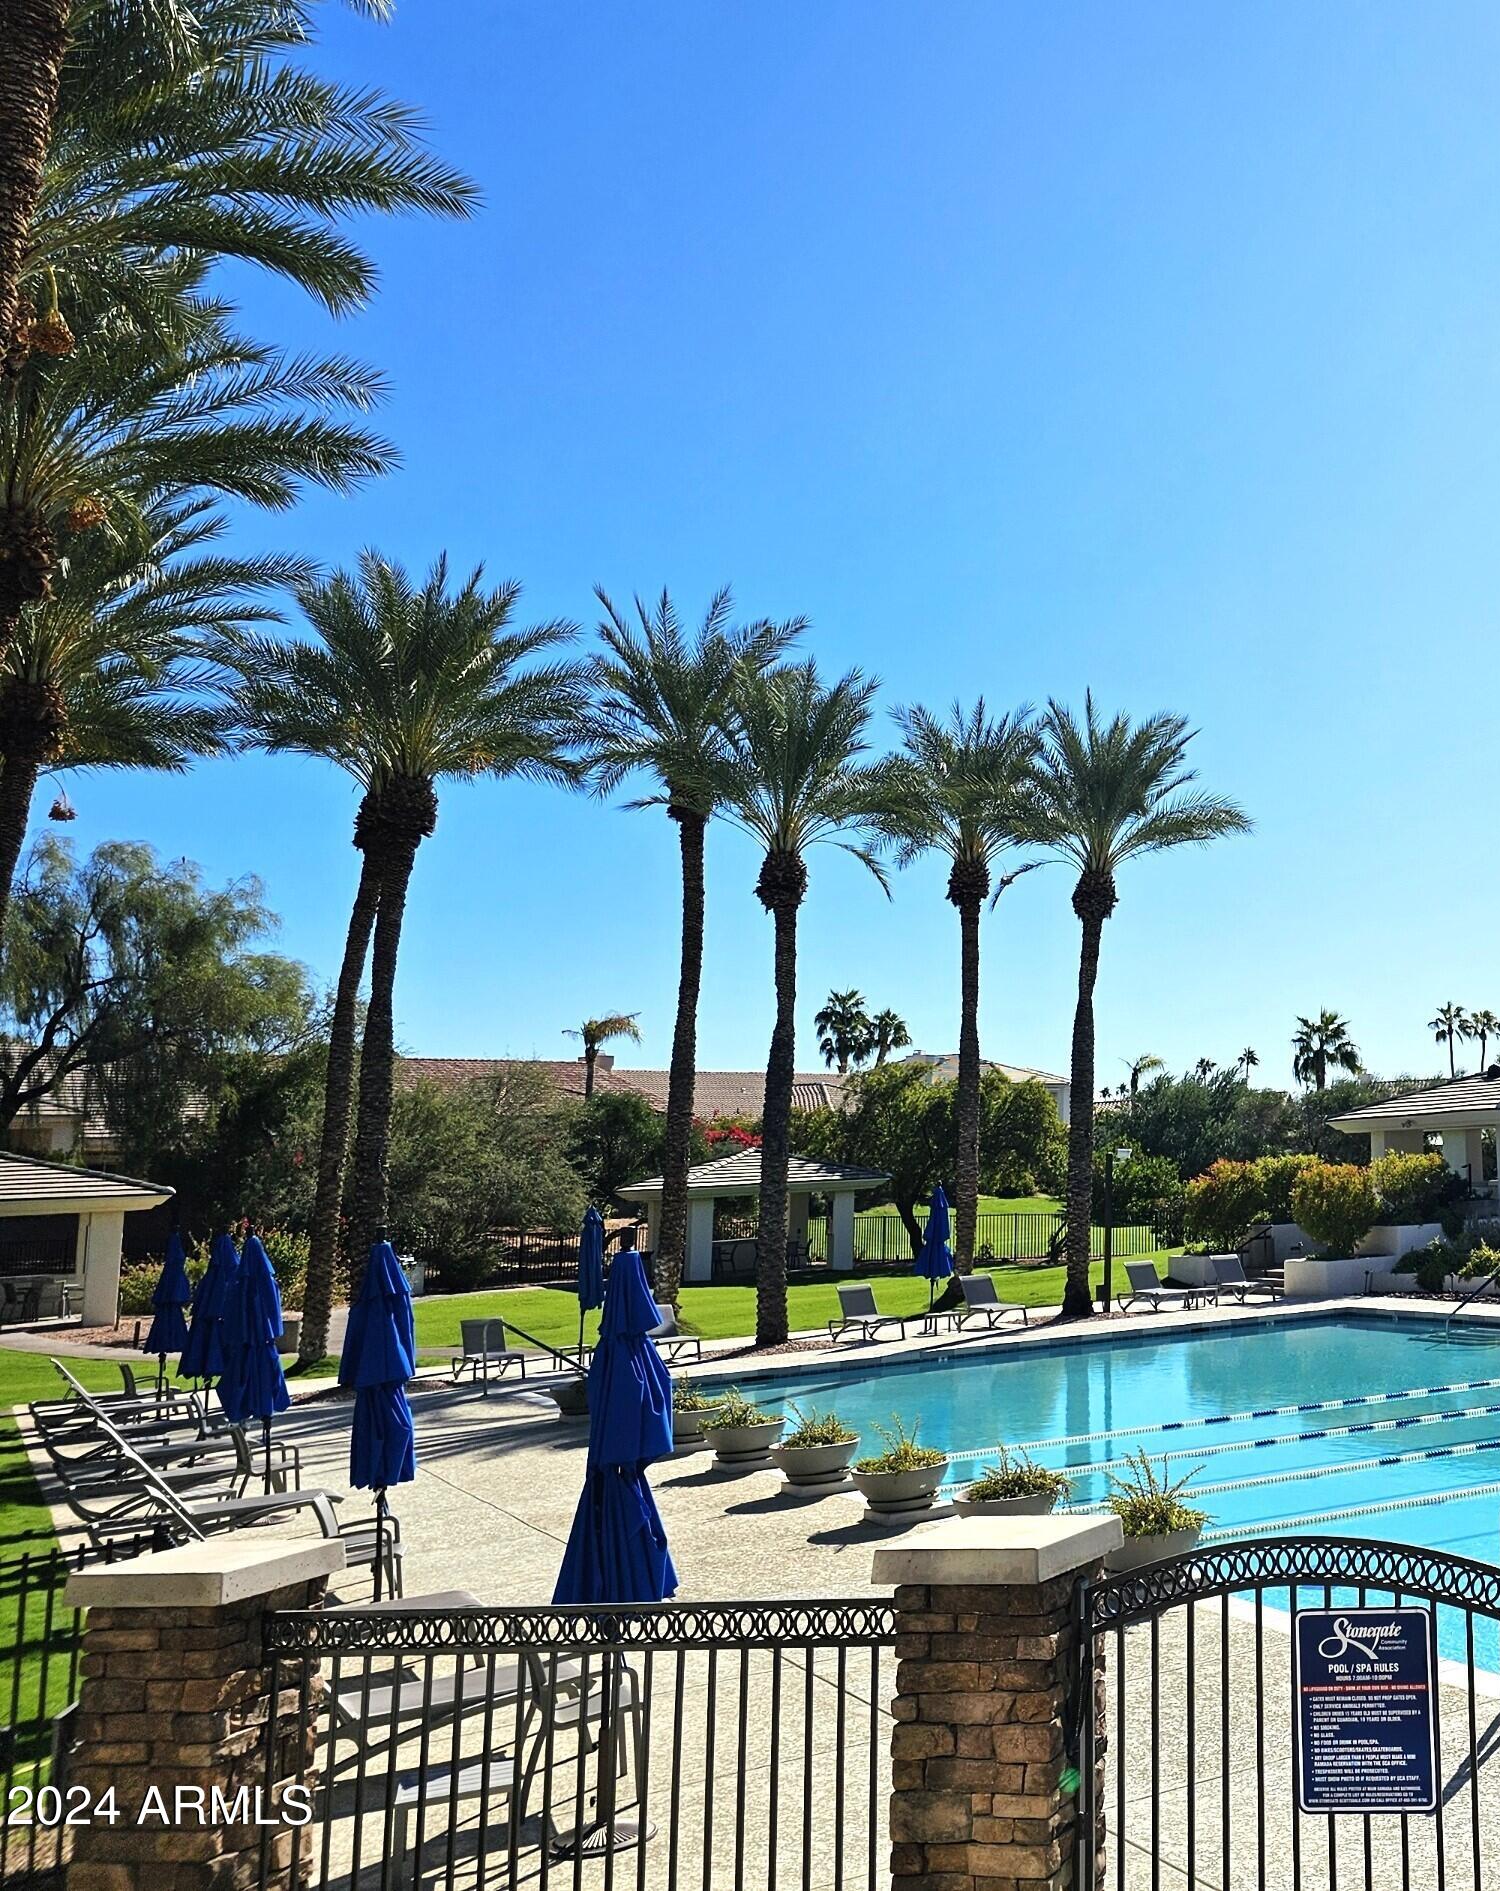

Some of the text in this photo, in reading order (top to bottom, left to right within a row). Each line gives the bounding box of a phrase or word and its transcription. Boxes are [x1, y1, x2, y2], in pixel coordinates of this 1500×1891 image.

[1318, 1617, 1402, 1659] Stonegate
[1328, 1663, 1399, 1673] POOL / SPA RULES
